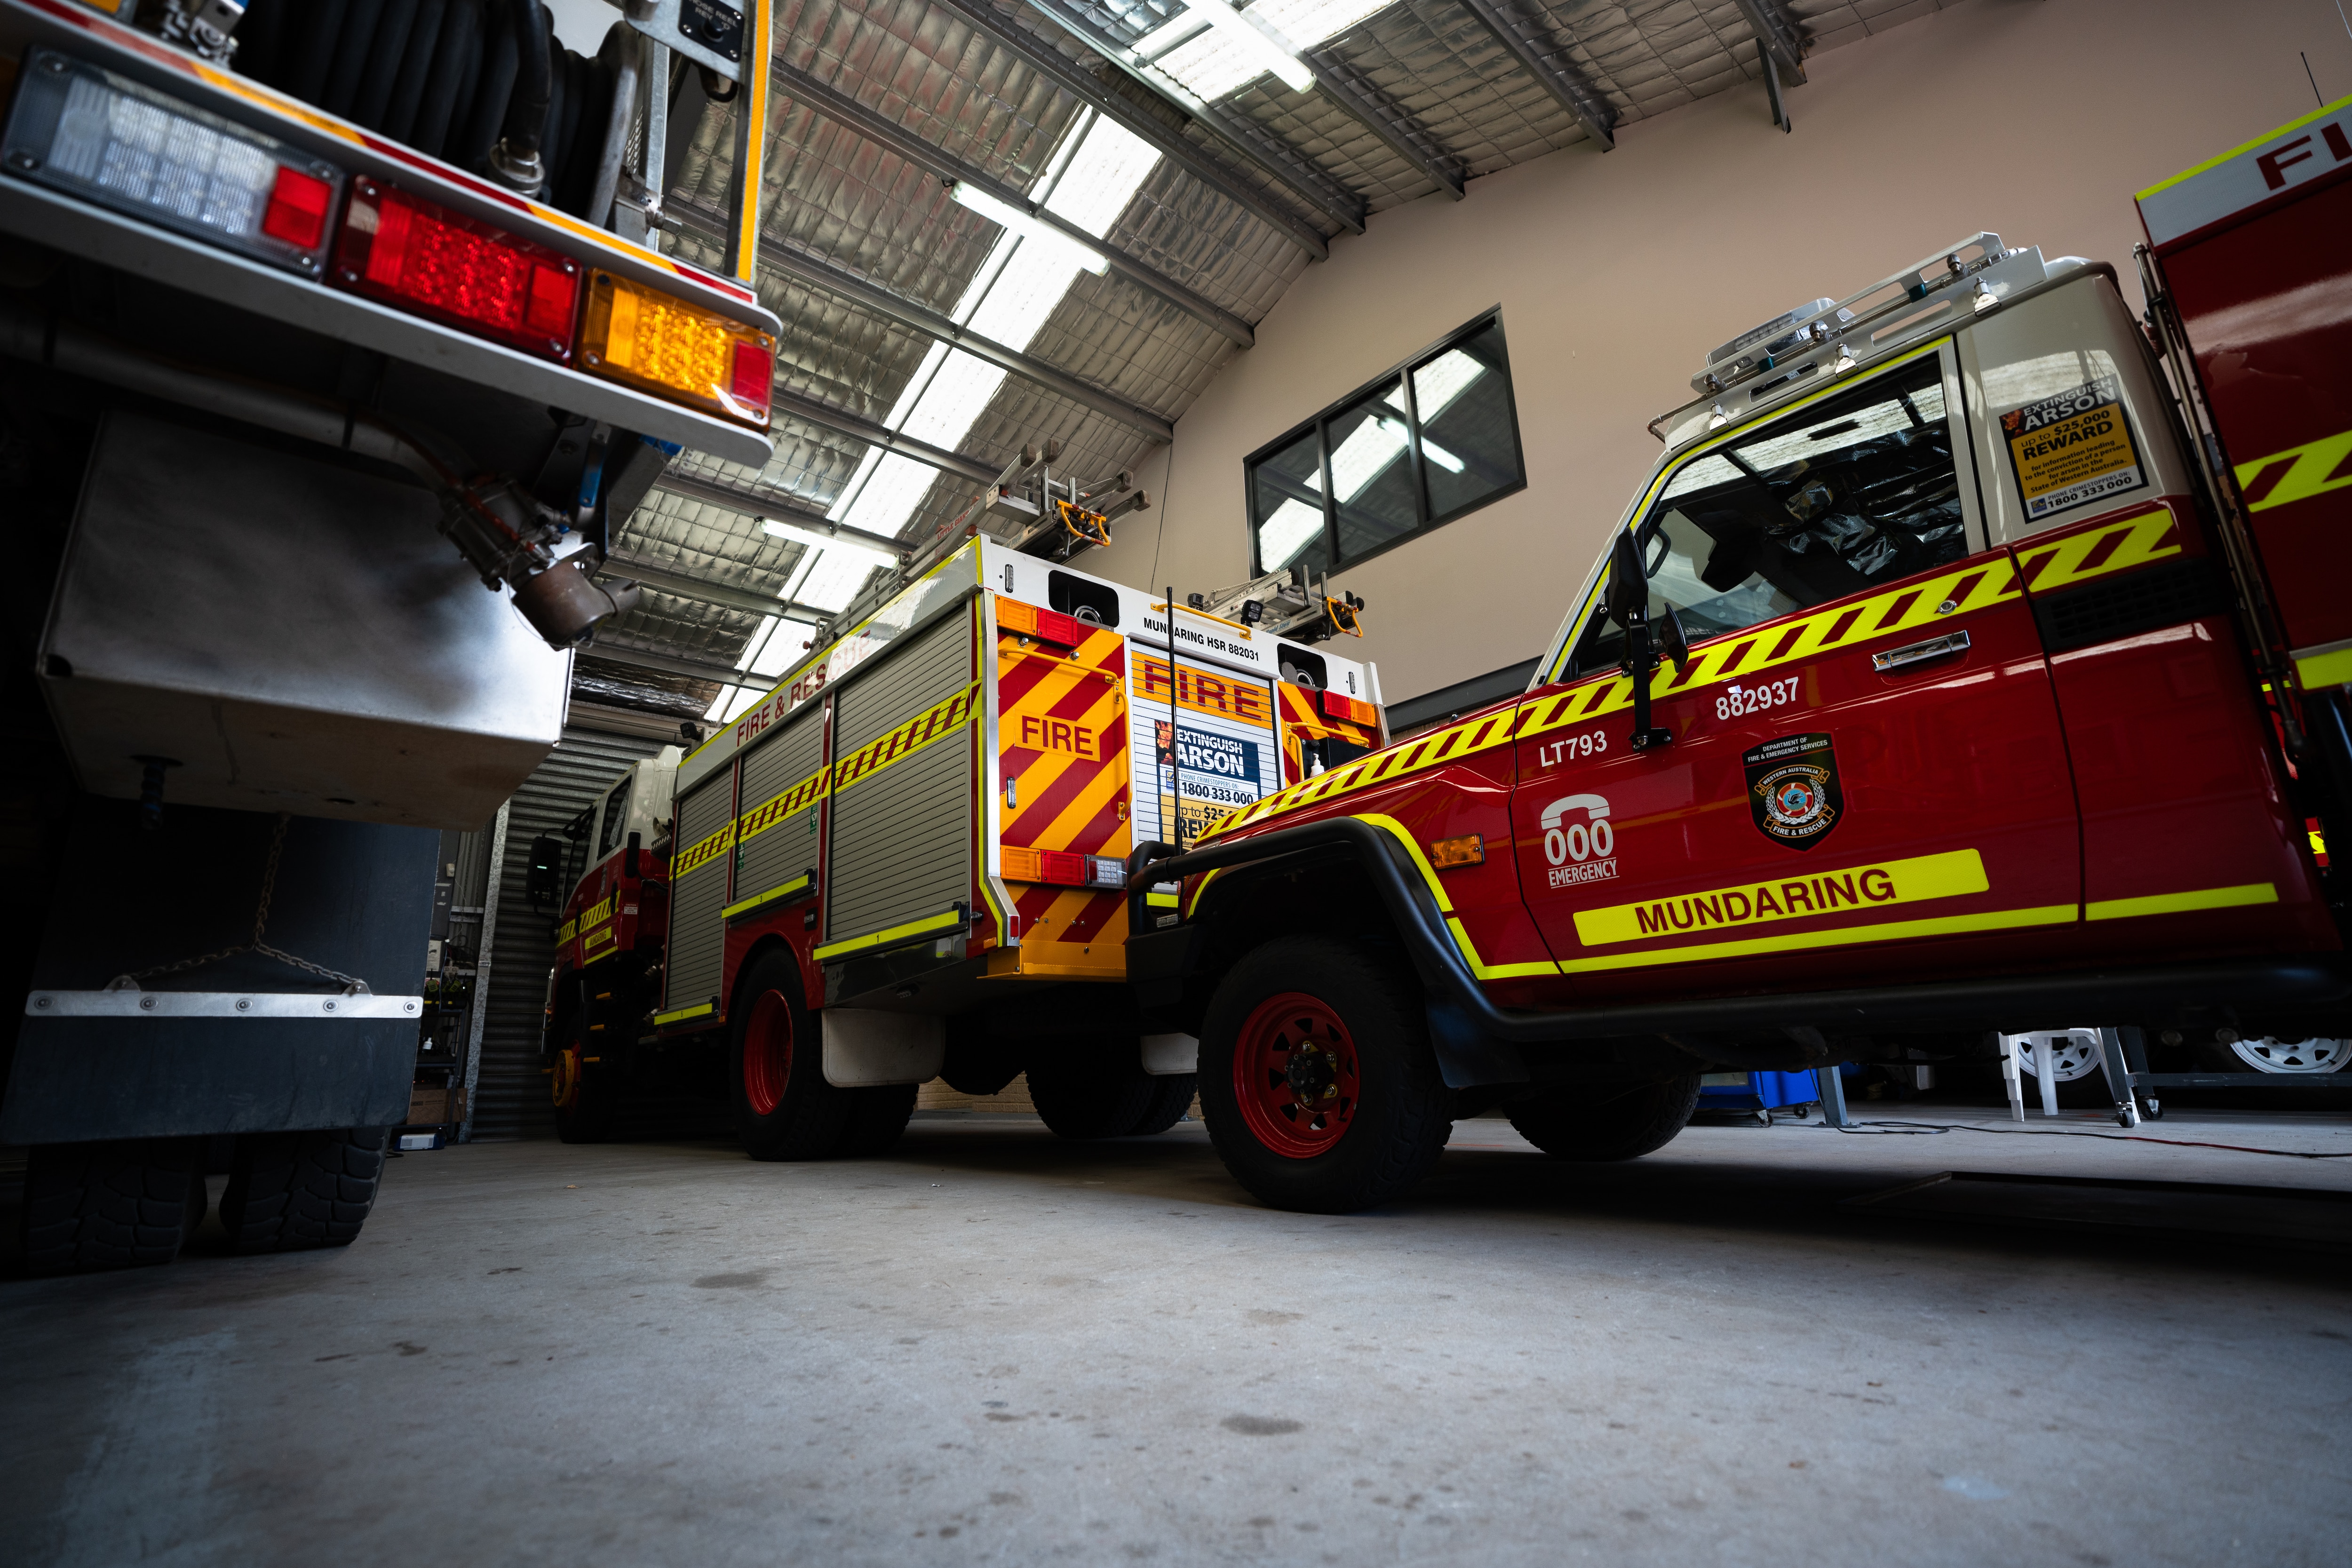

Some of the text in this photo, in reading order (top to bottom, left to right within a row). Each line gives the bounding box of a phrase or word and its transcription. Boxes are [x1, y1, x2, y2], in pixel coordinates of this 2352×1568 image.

[715, 10, 738, 27] REEL
[2256, 122, 2352, 191] FI
[2024, 378, 2112, 416] EXTINGUISH
[2025, 386, 2116, 431] ARSON
[2021, 410, 2110, 448] up to $25,000
[2023, 421, 2113, 461] REWARD
[2034, 470, 2046, 479] the
[2047, 457, 2083, 473] conviction
[2085, 454, 2093, 463] of
[2100, 444, 2126, 457] person
[2043, 450, 2085, 467] information
[2086, 440, 2115, 453] leading
[2060, 465, 2081, 476] arson
[2090, 457, 2103, 467] the
[2031, 459, 2127, 493] State of Western Australia.
[2048, 470, 2130, 501] PHONE CRIMESTOPPERS ON:
[2048, 477, 2132, 508] 1800 333 000
[938, 522, 954, 541] LITTLE
[1207, 637, 1226, 652] HSR
[1229, 644, 1259, 661] 882031
[737, 629, 871, 747] FIRE & RESCUE
[1144, 660, 1262, 721] FIRE
[1716, 675, 1800, 721] 882937
[1022, 715, 1094, 756] FIRE
[1176, 728, 1243, 755] EXTINGUISH
[1540, 730, 1607, 767] LT793
[1763, 739, 1799, 752] DEPARTMENT
[1766, 746, 1799, 758] EMERGENCY
[1801, 740, 1828, 751] SERVICES
[1177, 742, 1245, 777] ARSON
[1181, 773, 1196, 781] PHONE
[1197, 776, 1231, 788] CRIMESTOPPERS
[1762, 766, 1819, 786] WESTERN AUSTRALIA
[1182, 782, 1209, 798] 1800
[1212, 788, 1231, 802] 333
[1233, 791, 1254, 805] 000
[1191, 806, 1201, 817] to
[1772, 826, 1789, 836] FIRE
[1798, 818, 1827, 835] RESCUE
[1544, 819, 1614, 866] 000
[1549, 860, 1617, 887] EMERGENCY
[1635, 868, 1897, 934] MUNDARING
[589, 930, 606, 947] MUNDARING
[876, 934, 880, 942] 1
